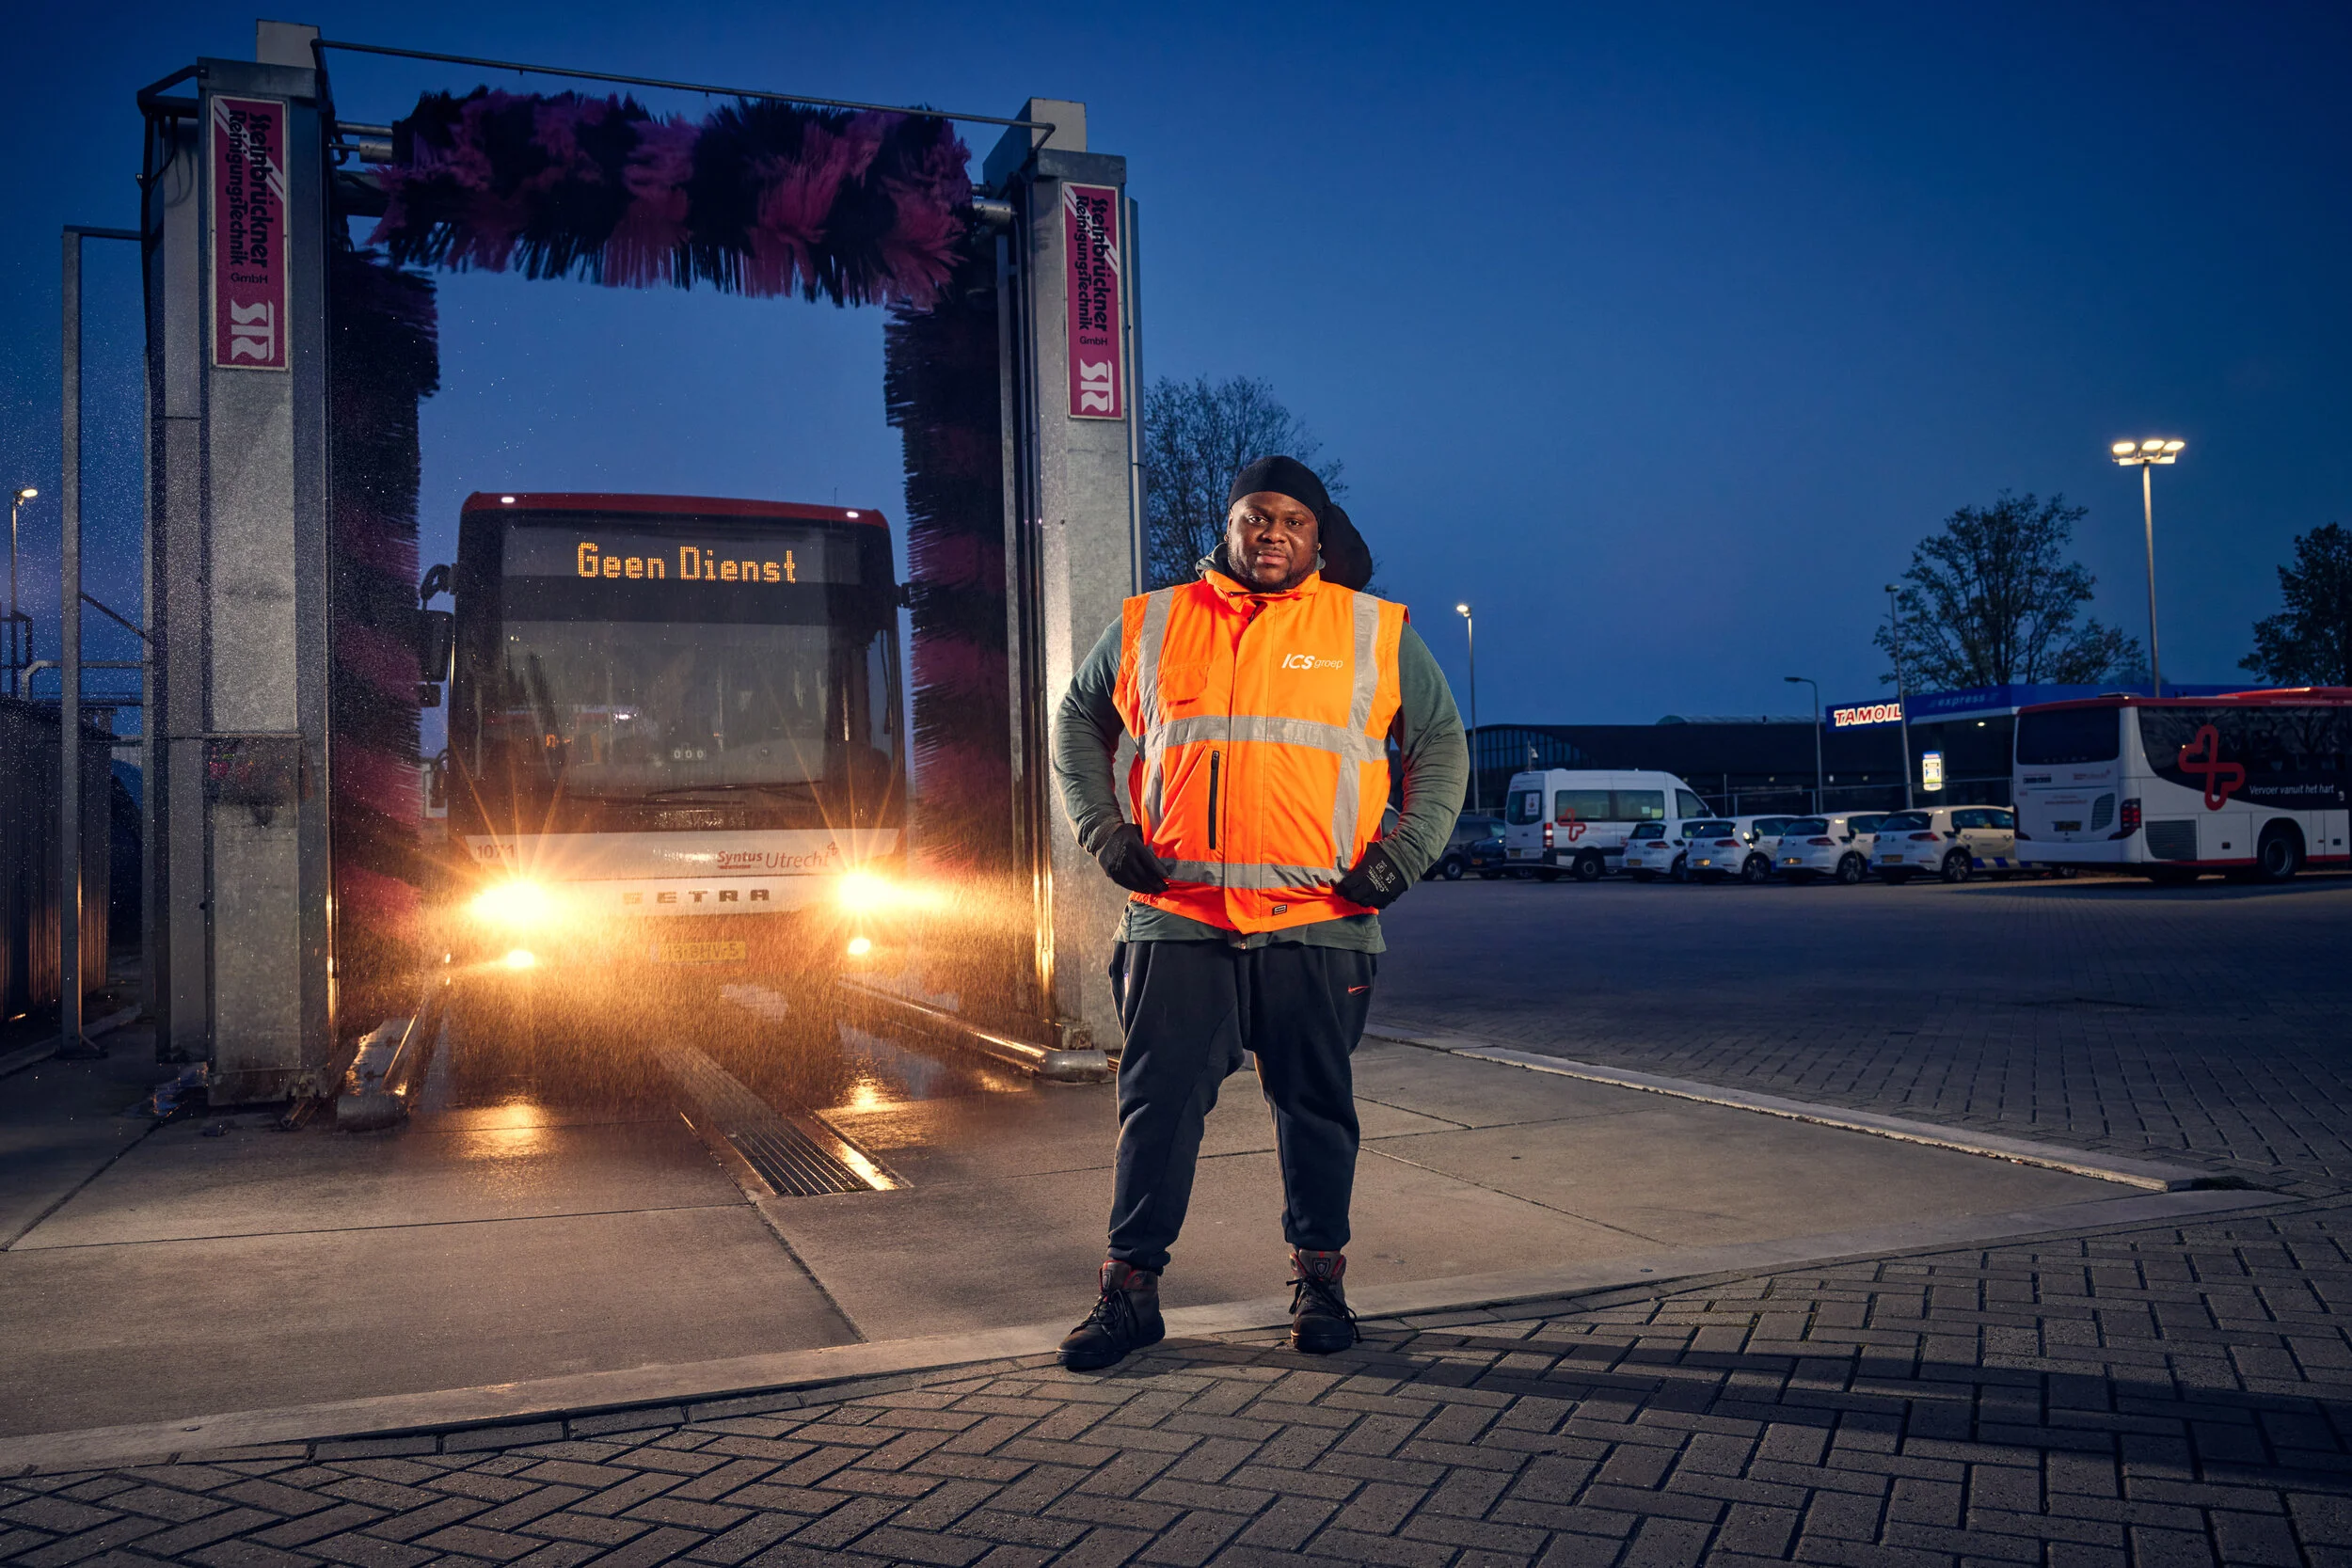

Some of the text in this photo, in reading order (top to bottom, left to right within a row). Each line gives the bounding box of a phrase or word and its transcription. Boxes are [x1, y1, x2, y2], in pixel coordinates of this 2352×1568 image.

[226, 109, 248, 266] ReinigungsTechnik
[249, 111, 274, 269] Steinbrückner
[1073, 195, 1093, 331] ReinigungsTechnik
[1091, 198, 1112, 333] Steinbrückner
[230, 272, 268, 284] GmbH
[1079, 335, 1107, 346] GmbH
[578, 542, 797, 584] Geen Dienst
[1281, 653, 1343, 671] ICS groep
[1937, 693, 1986, 707] express
[1834, 703, 1902, 727] TAMOIL
[2249, 784, 2334, 795] Vervoer vanuit het hart
[717, 850, 832, 868] Syntus Utrecht
[623, 888, 770, 904] SETRA
